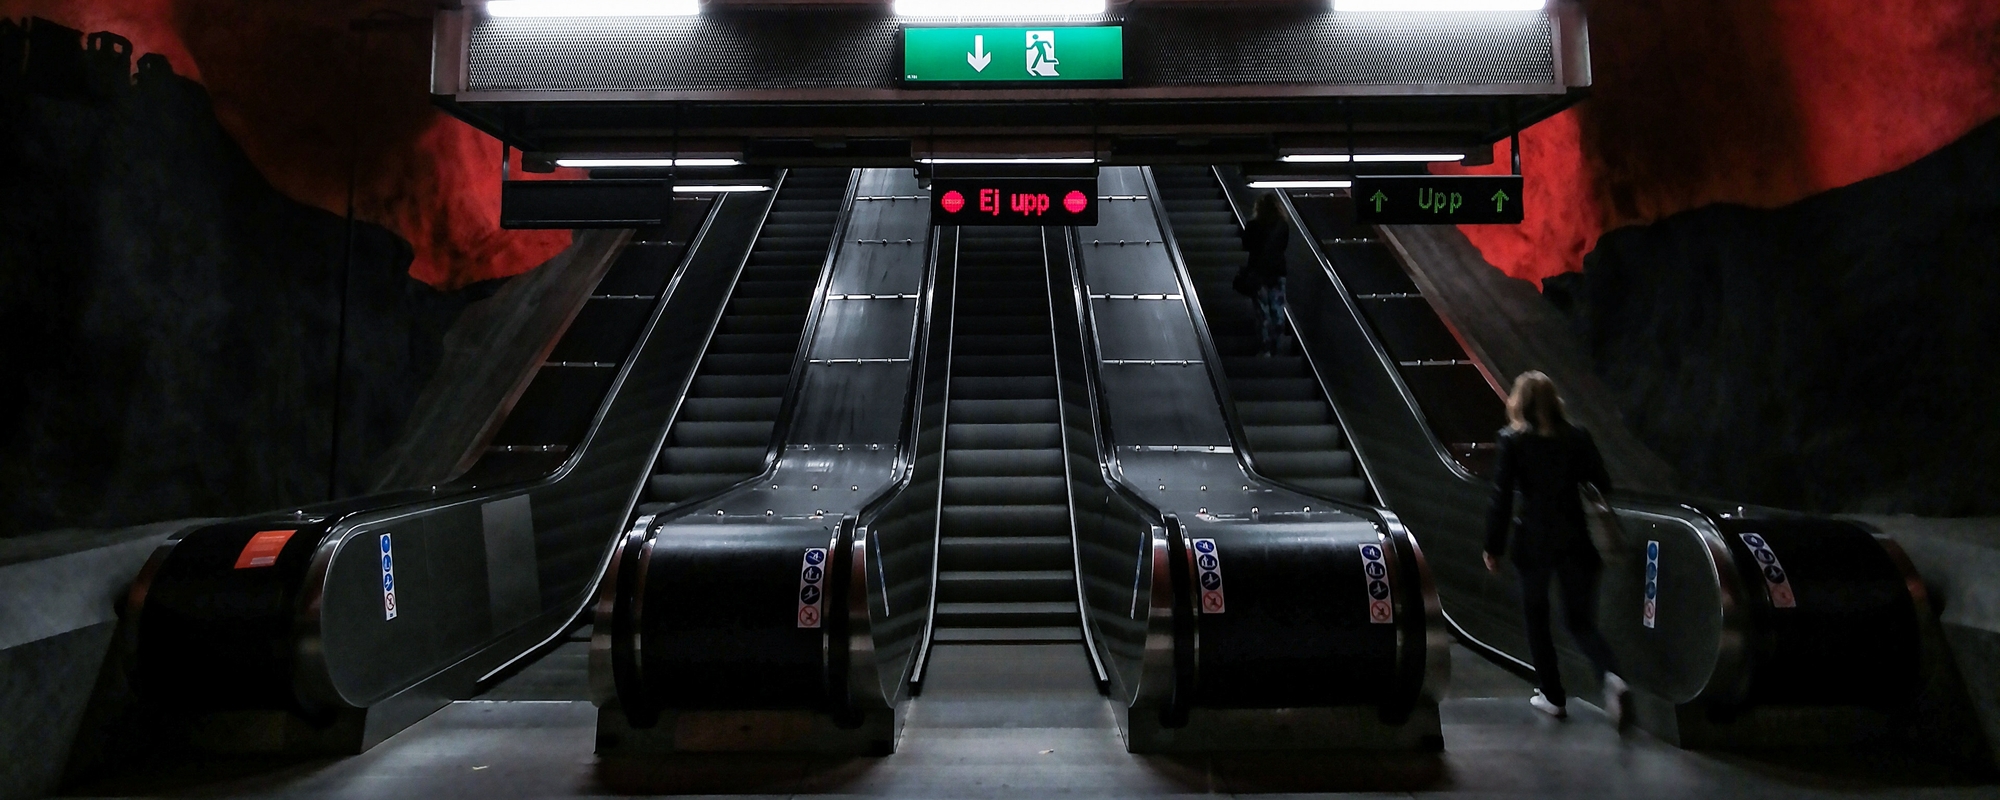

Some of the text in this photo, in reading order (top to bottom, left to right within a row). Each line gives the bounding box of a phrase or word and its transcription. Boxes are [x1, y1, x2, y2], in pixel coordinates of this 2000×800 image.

[980, 189, 1049, 216] Ej upp
[1419, 188, 1463, 214] Upp
